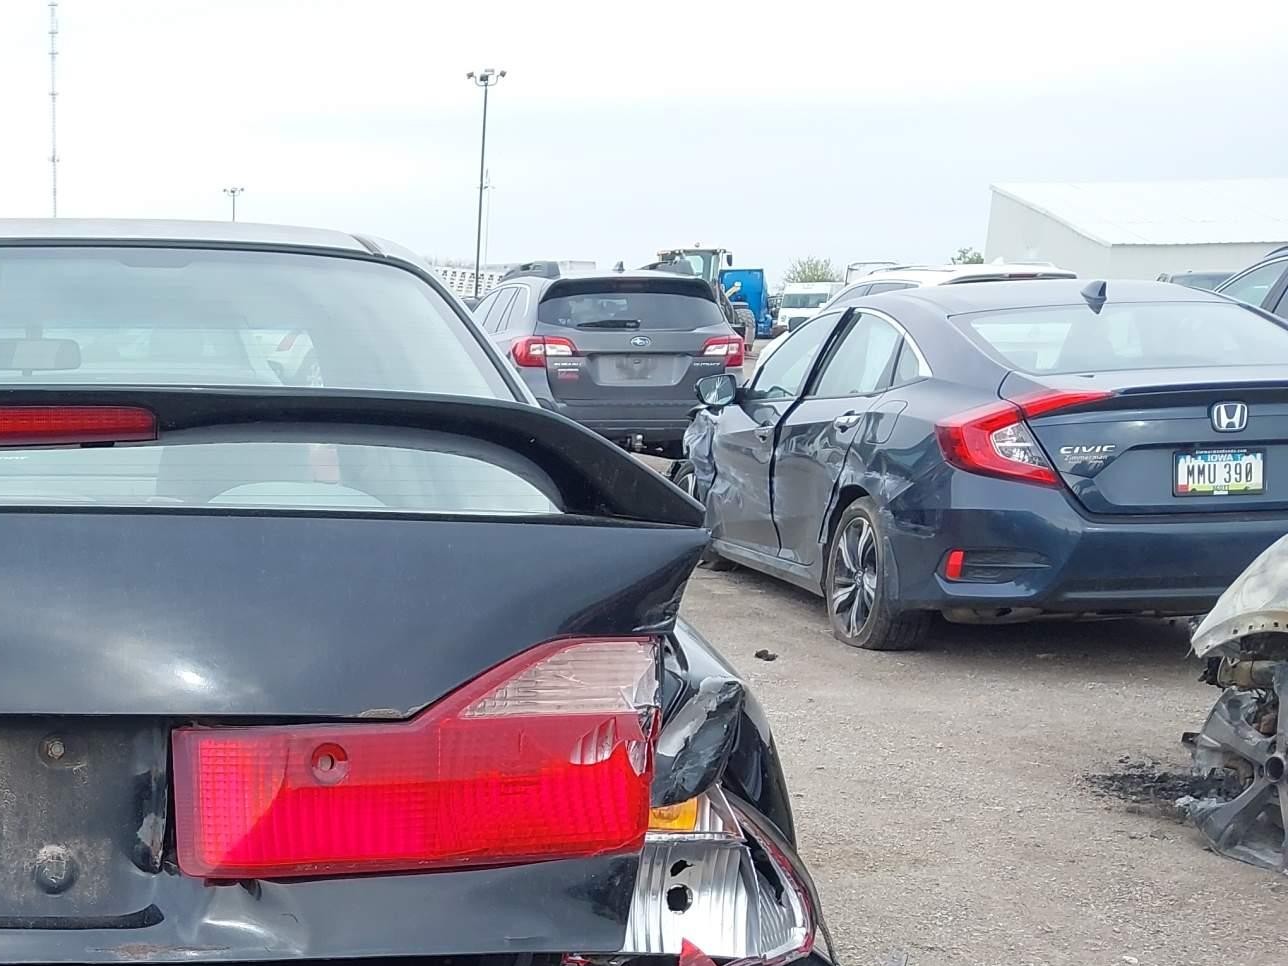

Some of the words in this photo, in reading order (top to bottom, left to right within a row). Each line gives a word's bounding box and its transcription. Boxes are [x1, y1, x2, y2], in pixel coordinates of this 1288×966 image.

[1059, 444, 1116, 454] CIVIC
[1207, 453, 1234, 462] IOWA
[1186, 463, 1217, 484] MMU
[1223, 462, 1253, 484] 390
